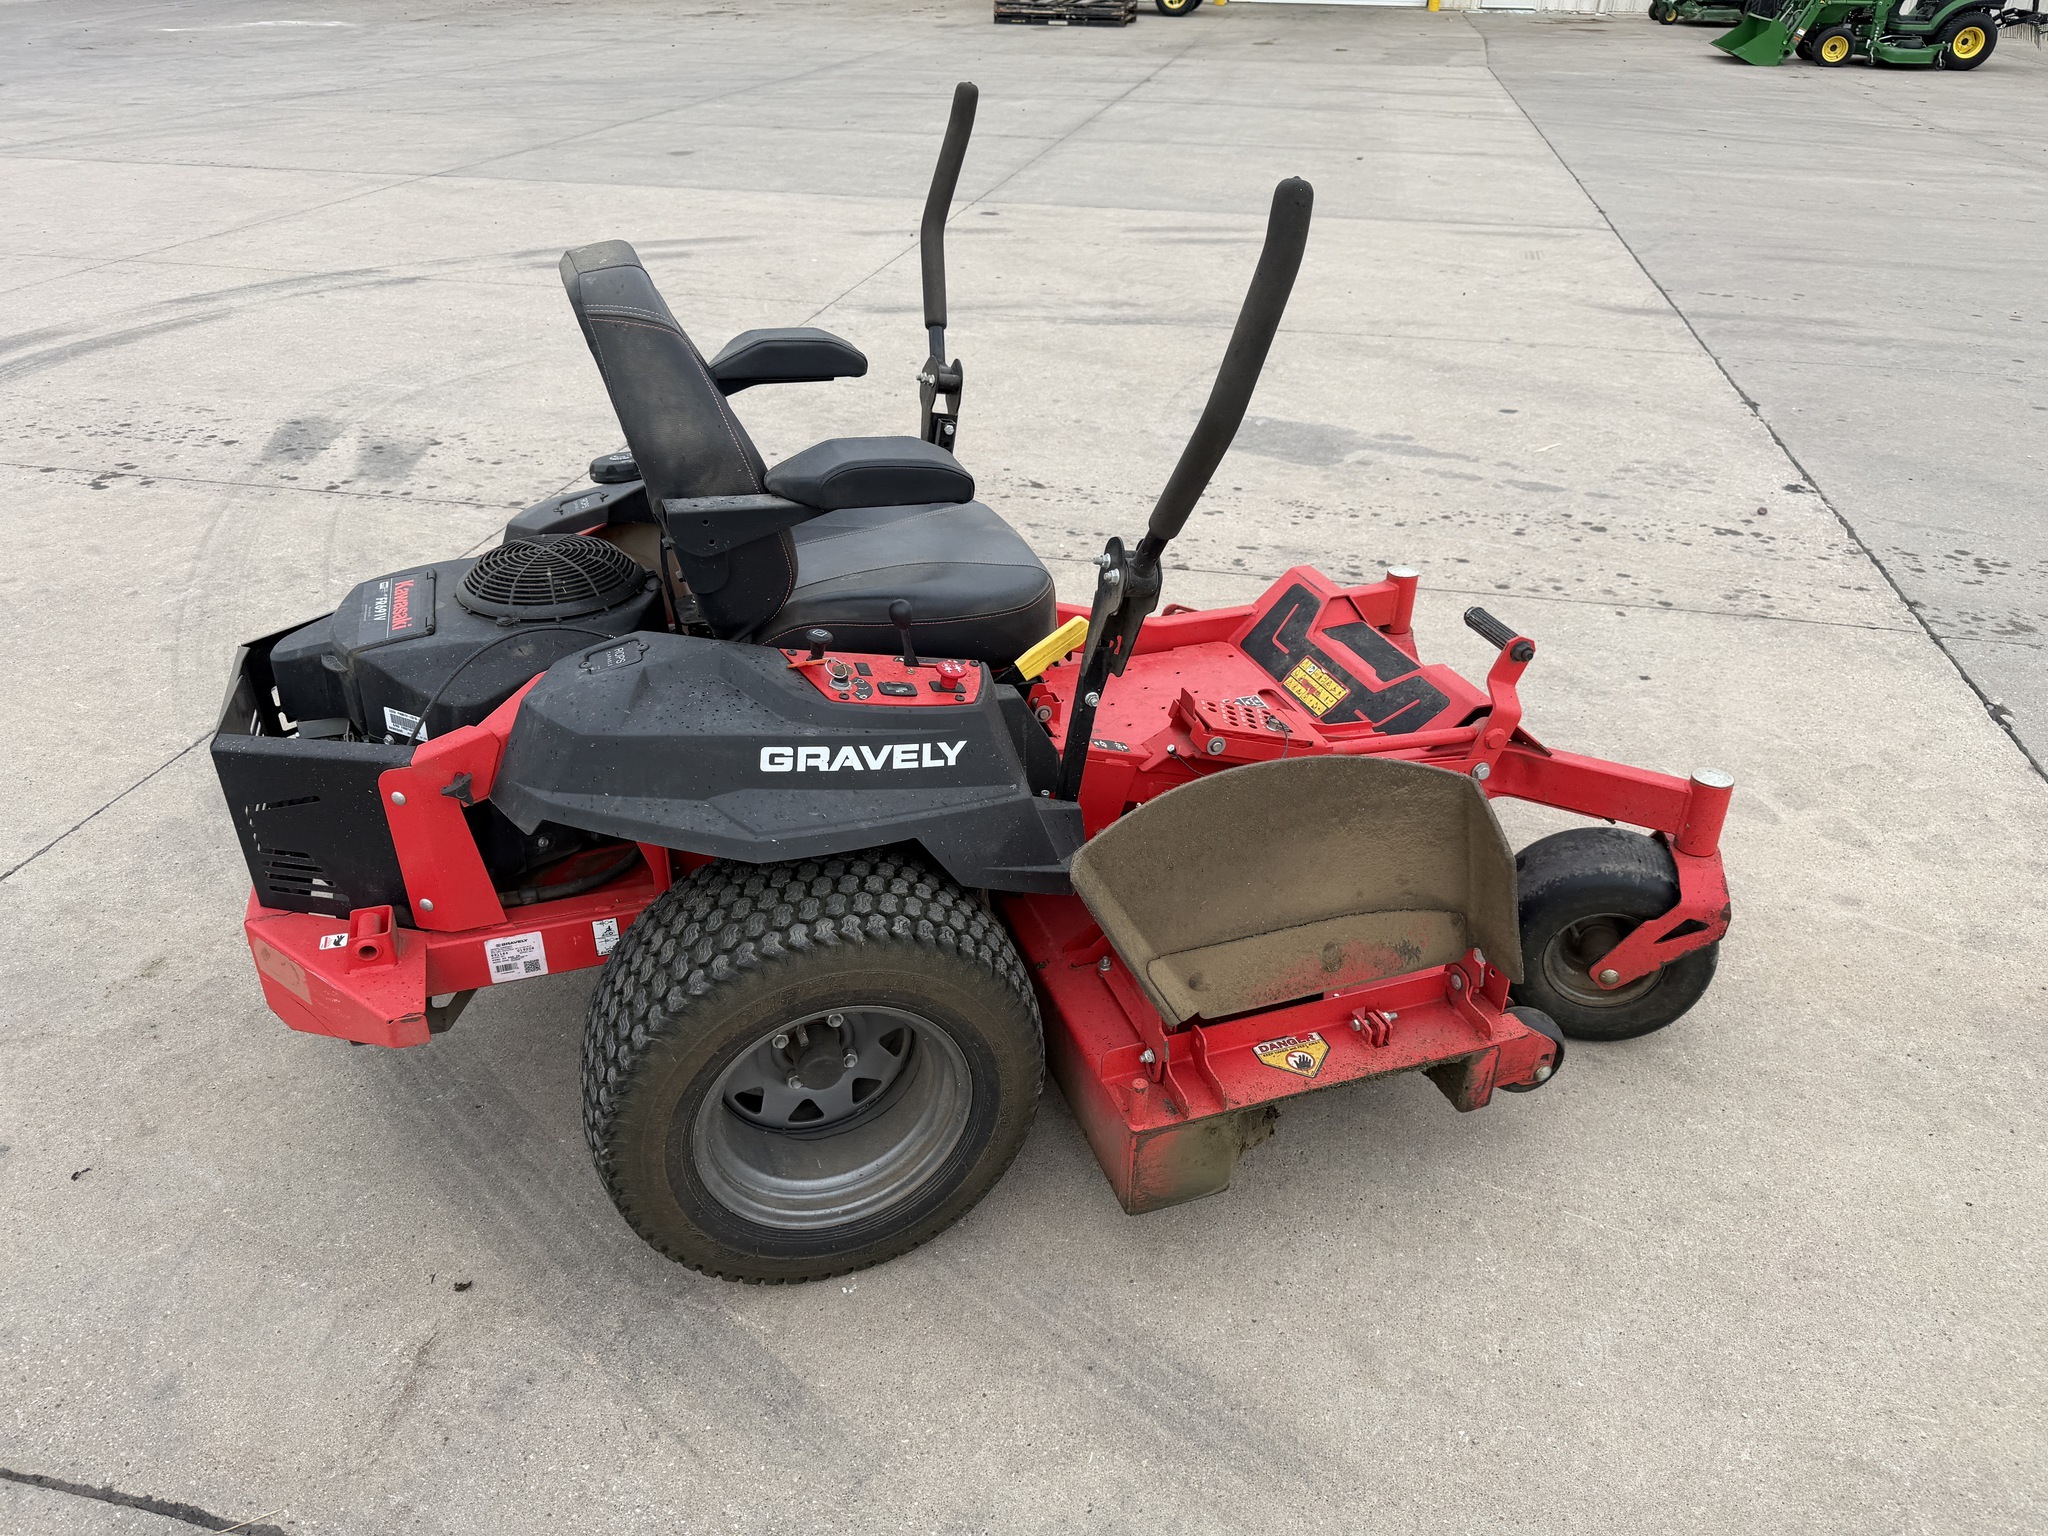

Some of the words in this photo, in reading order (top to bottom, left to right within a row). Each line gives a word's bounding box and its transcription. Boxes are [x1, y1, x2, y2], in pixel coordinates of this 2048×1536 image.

[373, 596, 388, 620] FR691V
[392, 579, 415, 630] Kawasaki
[613, 647, 626, 664] ROPS
[760, 740, 967, 772] GRAVELY
